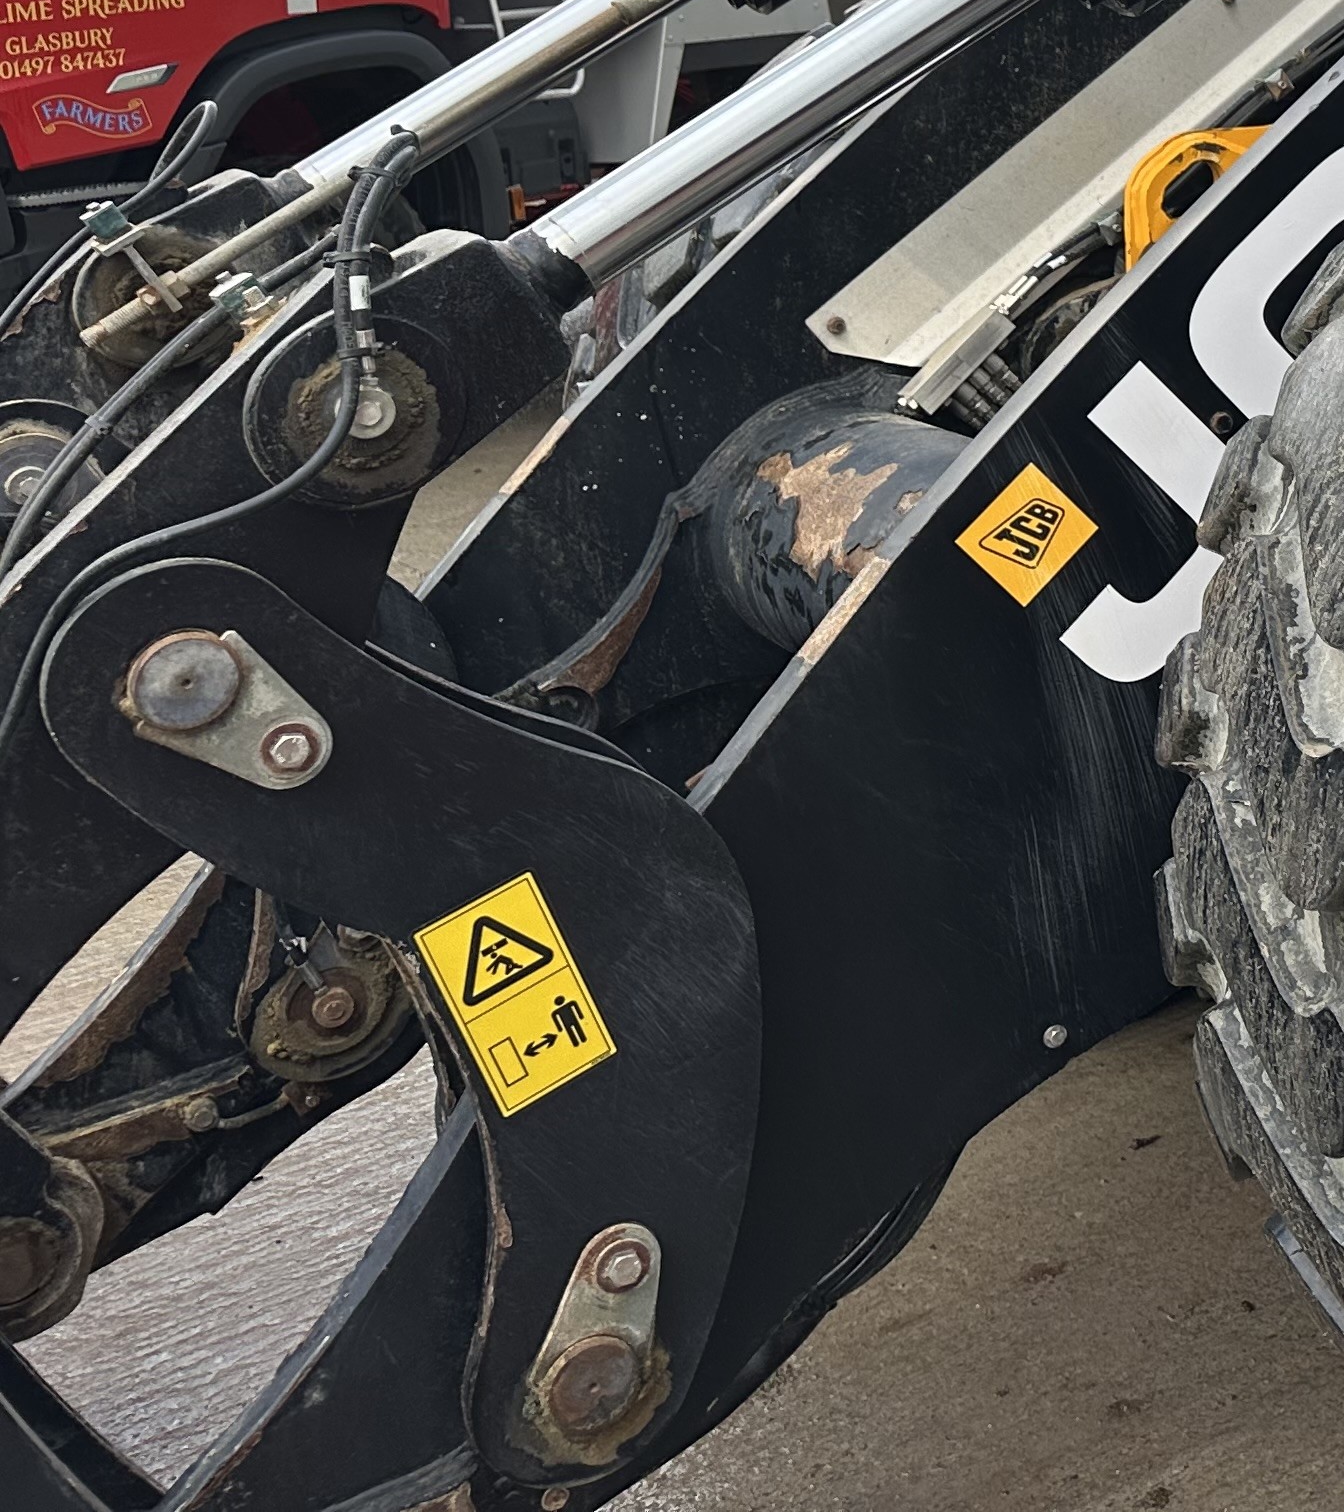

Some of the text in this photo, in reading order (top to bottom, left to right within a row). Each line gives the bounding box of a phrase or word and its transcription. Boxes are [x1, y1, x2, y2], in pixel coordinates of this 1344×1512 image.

[5, 27, 115, 56] GLASBURY
[0, 48, 126, 80] 01497 847437
[41, 98, 144, 134] FARMERS
[992, 502, 1060, 562] JCB
